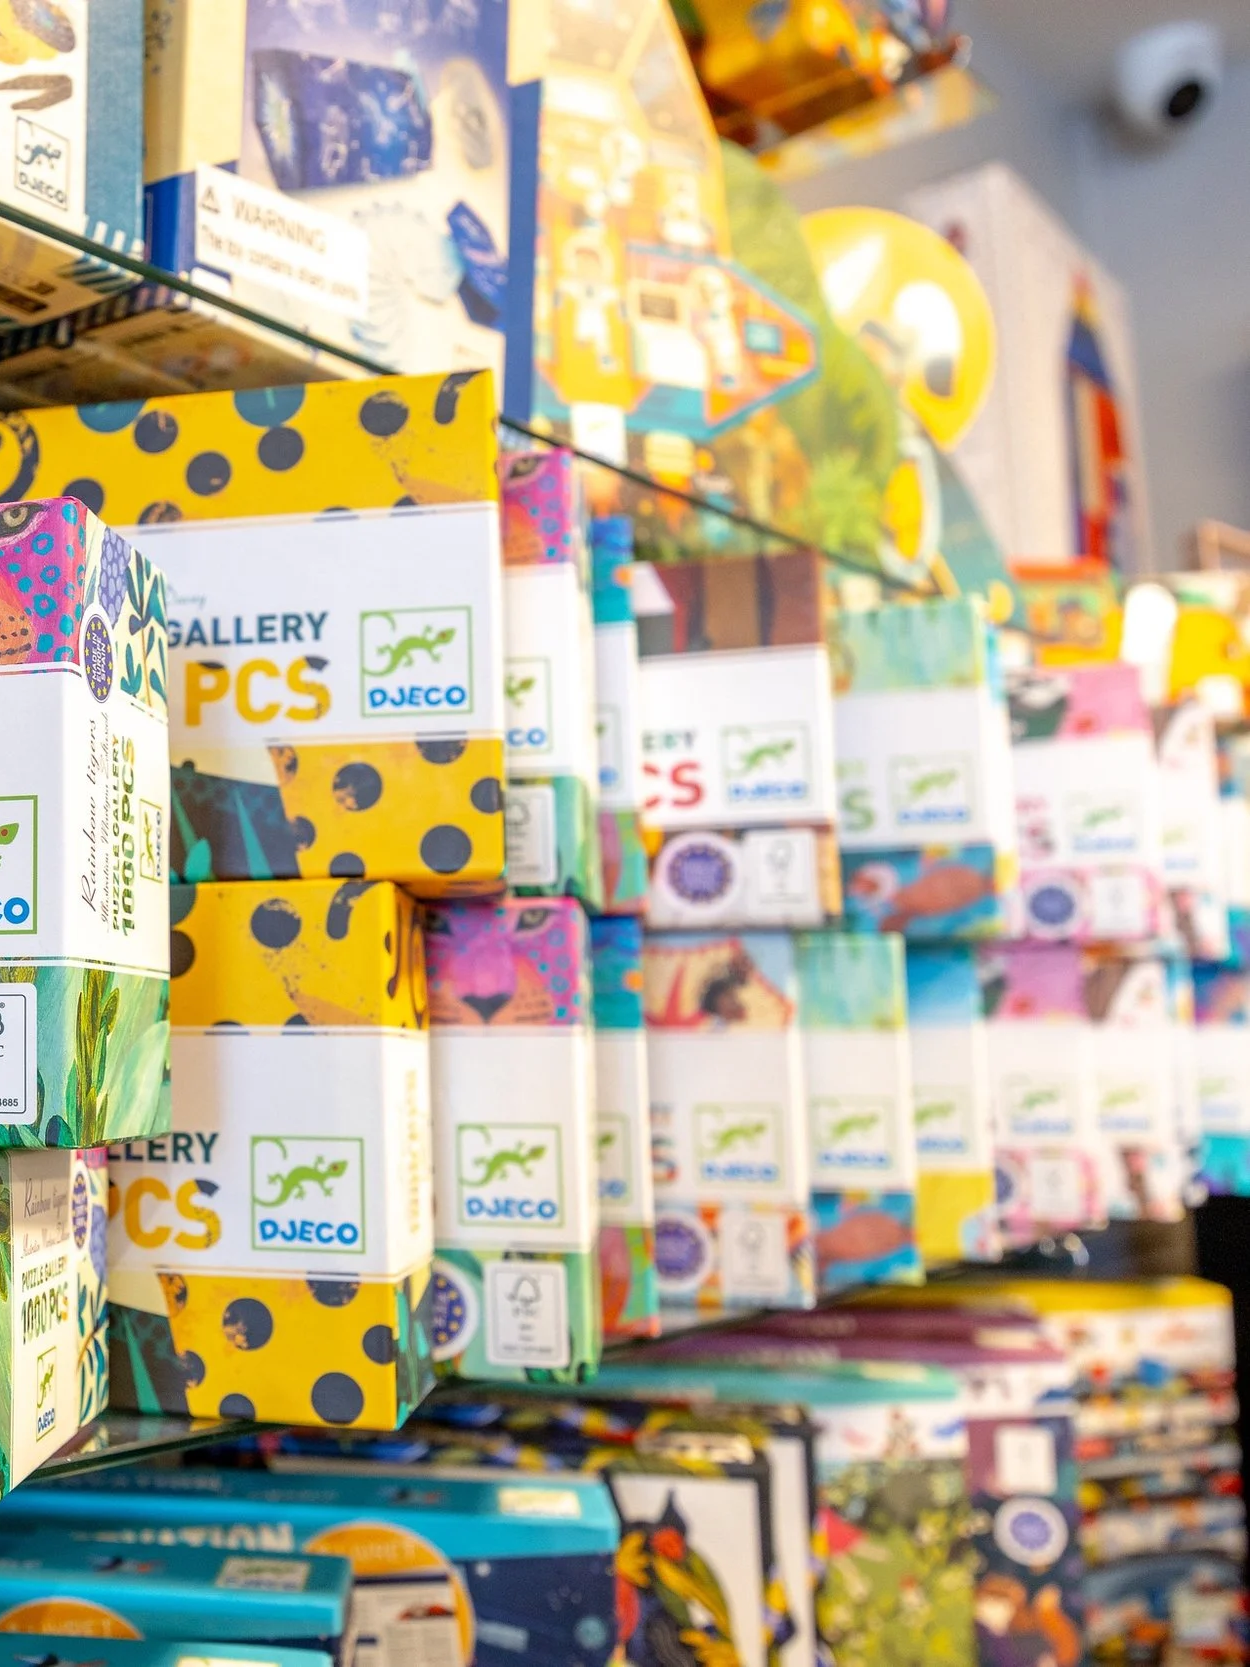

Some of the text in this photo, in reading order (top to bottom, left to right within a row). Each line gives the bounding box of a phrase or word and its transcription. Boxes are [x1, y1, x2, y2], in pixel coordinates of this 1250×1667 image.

[19, 171, 66, 204] DJECO
[184, 655, 333, 729] PCS
[369, 684, 467, 709] DJECO
[112, 733, 120, 931] PUZZLE GALLERY
[122, 736, 135, 936] 1000 PCS
[465, 1197, 559, 1221] DJECO
[259, 1218, 360, 1247] DJECO
